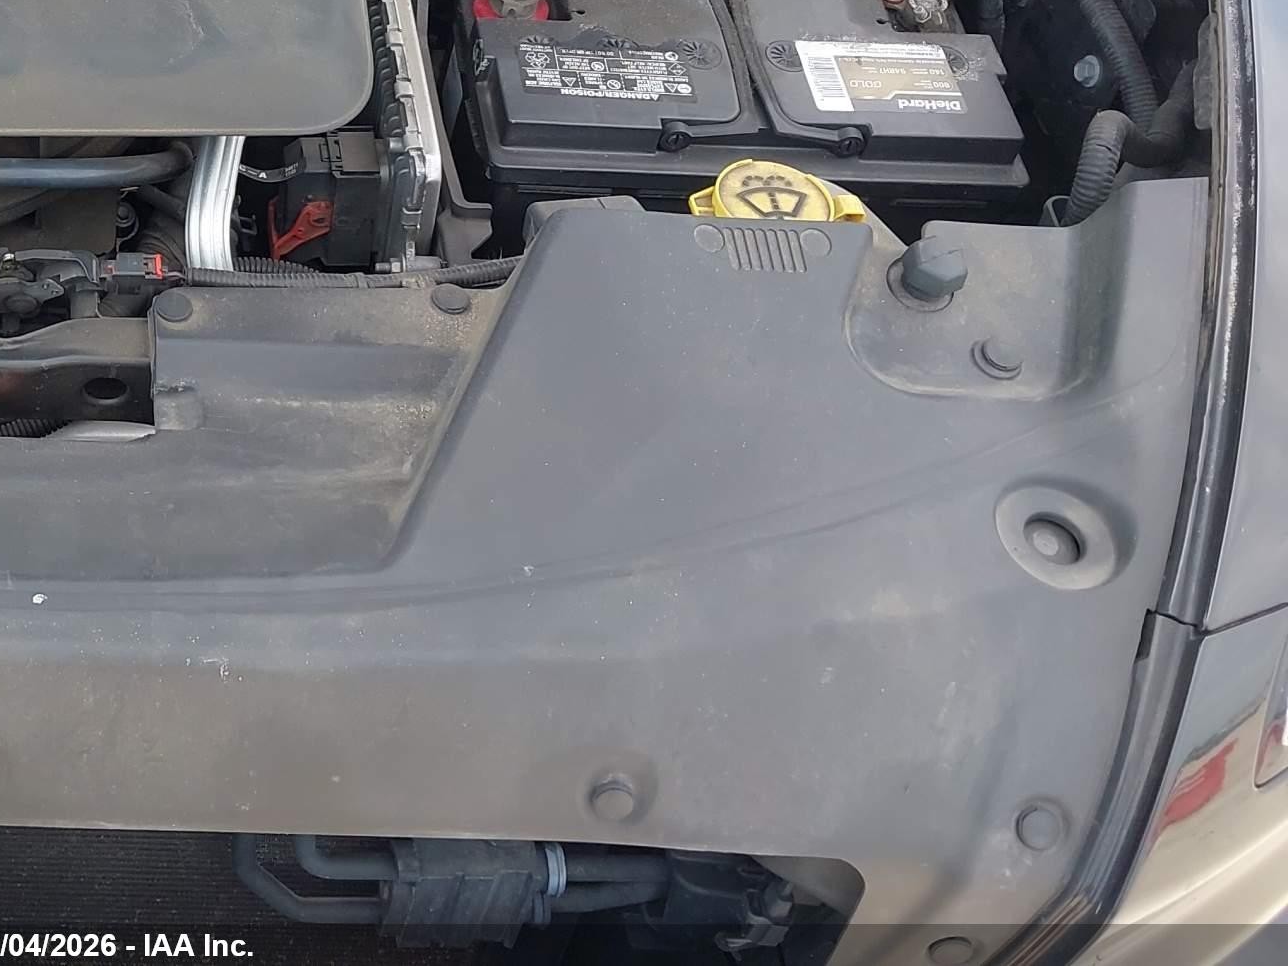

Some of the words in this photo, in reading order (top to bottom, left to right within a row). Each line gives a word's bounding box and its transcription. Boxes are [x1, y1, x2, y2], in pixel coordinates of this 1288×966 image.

[850, 80, 882, 89] GOLD
[561, 89, 652, 99] DANGER/POISON
[898, 98, 961, 111] DieHard
